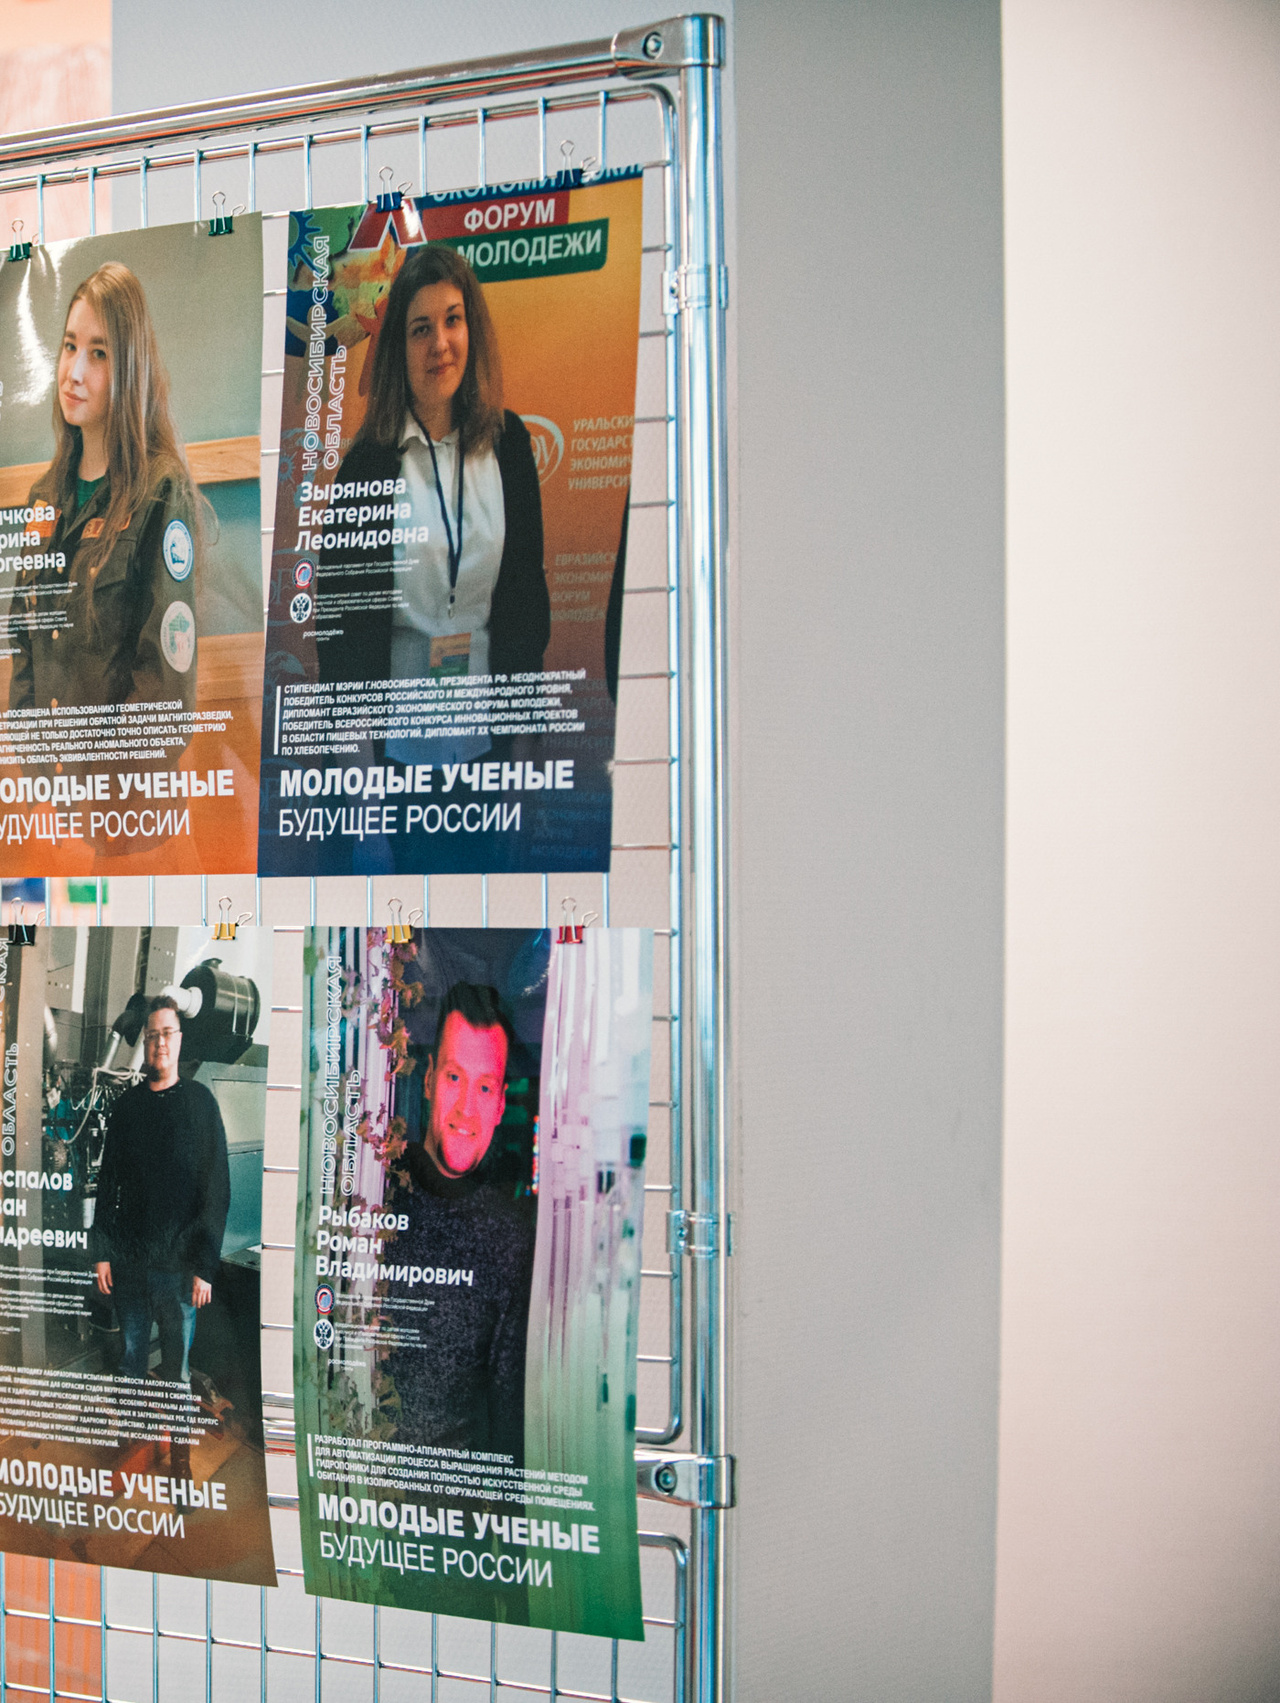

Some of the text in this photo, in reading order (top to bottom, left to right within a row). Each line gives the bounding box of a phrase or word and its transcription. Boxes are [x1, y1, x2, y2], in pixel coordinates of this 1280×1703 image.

[464, 198, 556, 232] ФОРУМ
[301, 235, 330, 471] НОВОСИБИРСКАЯ
[323, 345, 347, 470] ОБЛАСТЬ
[299, 477, 407, 503] Зырянова
[298, 500, 412, 528] Екатерина
[294, 524, 429, 552] Леонидовна
[284, 682, 335, 694] СТИПЕНДИАТ
[336, 681, 364, 691] МЭРИИ
[440, 674, 493, 686] ПРЕЗИДЕНТА
[494, 673, 509, 684] РФ.
[511, 669, 586, 683] НЕОДНОКРАТНЫЙ
[284, 683, 573, 706] ПОБЕДИТЕЛЬ КОНКУРСОВ РОССИЙСКОГО И МЕЖДУНАРОДНОГО УРОВНЯ,
[39, 720, 53, 728] ПРИ
[54, 718, 88, 728] РЕШЕНИИ
[89, 716, 126, 726] ОБРАТНОЙ
[128, 714, 157, 724] ЗАДАЧИ
[158, 710, 233, 723] МАГНИТОРАЗВЕДКИ,
[52, 704, 115, 716] ИСПОЛЬЗОВАНИЮ
[116, 700, 182, 713] ГЕОМЕТРИЧЕСКОЙ
[283, 707, 331, 719] ДИПЛОМАНТ
[332, 705, 394, 717] ЕВРАЗИЙСКОГО
[395, 701, 472, 714] ЭКОНОМИЧЕСКОГО
[474, 700, 509, 711] ФОРУМА
[283, 709, 578, 731] ПОБЕДИТЕЛЬ ВСЕРОССИЙСКОГО КОНКУРСА ИННОВАЦИОННЫХ ПРОЕКТОВ
[31, 731, 40, 740] НЕ
[41, 730, 68, 740] ТОЛЬКО
[69, 728, 116, 738] ДОСТАТОЧНО
[117, 727, 142, 736] ТОЧНО
[143, 725, 177, 735] ОПИСАТЬ
[178, 723, 226, 734] ГЕОМЕТРИЮ
[52, 741, 92, 751] РЕАЛЬНОГО
[94, 738, 148, 750] АНОМАЛЬНОГО
[150, 737, 186, 748] ОБЪЕКТА,
[282, 734, 288, 743] В
[289, 732, 325, 743] ОБЛАСТИ
[326, 731, 367, 741] ПИЩЕВЫХ
[424, 726, 476, 738] ДИПЛОМАНТ
[490, 723, 547, 735] ЧЕМПИОНАТА
[548, 722, 585, 733] РОССИИ
[26, 754, 58, 764] ОБЛАСТЬ
[59, 750, 128, 763] ЭКВИВАЛЕНТНОСТИ
[130, 749, 167, 760] РЕШЕНИЙ.
[282, 743, 360, 756] ПО ХЛЕБОПЕЧЕНИЮ.
[118, 769, 235, 800] УЧЕНЫЕ
[280, 760, 574, 800] МОЛОДЫЕ УЧЕНЫЕ
[90, 808, 190, 838] РОССИИ
[279, 802, 521, 841] БУДУЩЕЕ РОССИИ
[320, 956, 342, 1195] НОВОСИБИРСКАЯ
[1, 1042, 18, 1157] ОБЛАСТЬ
[340, 1069, 362, 1197] ОБЛАСТЬ
[318, 1205, 409, 1231] Рыбаков
[317, 1230, 383, 1254] Роман
[316, 1255, 474, 1287] Владимирович
[314, 1434, 513, 1464] РАЗРАБОТАЛ ПРОГРАММНО-АППАРАТНЫЙ КОМПЛЕКС
[315, 1446, 588, 1485] ДЛЯ АВТОМАТИЗАЦИИ ПРОЦЕССА ВЫРАЩИВАНИЯ РАСТЕНИЙ МЕТОДОМ
[316, 1458, 582, 1497] ГИДРОПОНИКИ ДЛЯ СОЗДАНИЯ ПОЛНОСТЬЮ ИСКУССТВЕННОЙ СРЕДЫ
[120, 1471, 228, 1511] УЧЕНЫЕ
[317, 1471, 355, 1484] ОБИТАНИЯ
[357, 1475, 362, 1484] В
[364, 1476, 431, 1492] ИЗОЛИРОВАННЫХ
[433, 1483, 443, 1494] ОТ
[445, 1485, 503, 1501] ОКРУЖАЮЩЕЙ
[504, 1491, 533, 1504] СРЕДЫ
[94, 1503, 185, 1539] РОССИИ
[318, 1493, 600, 1554] МОЛОДЫЕ УЧЕНЫЕ
[320, 1531, 553, 1588] БУДУЩЕЕ РОССИИ
